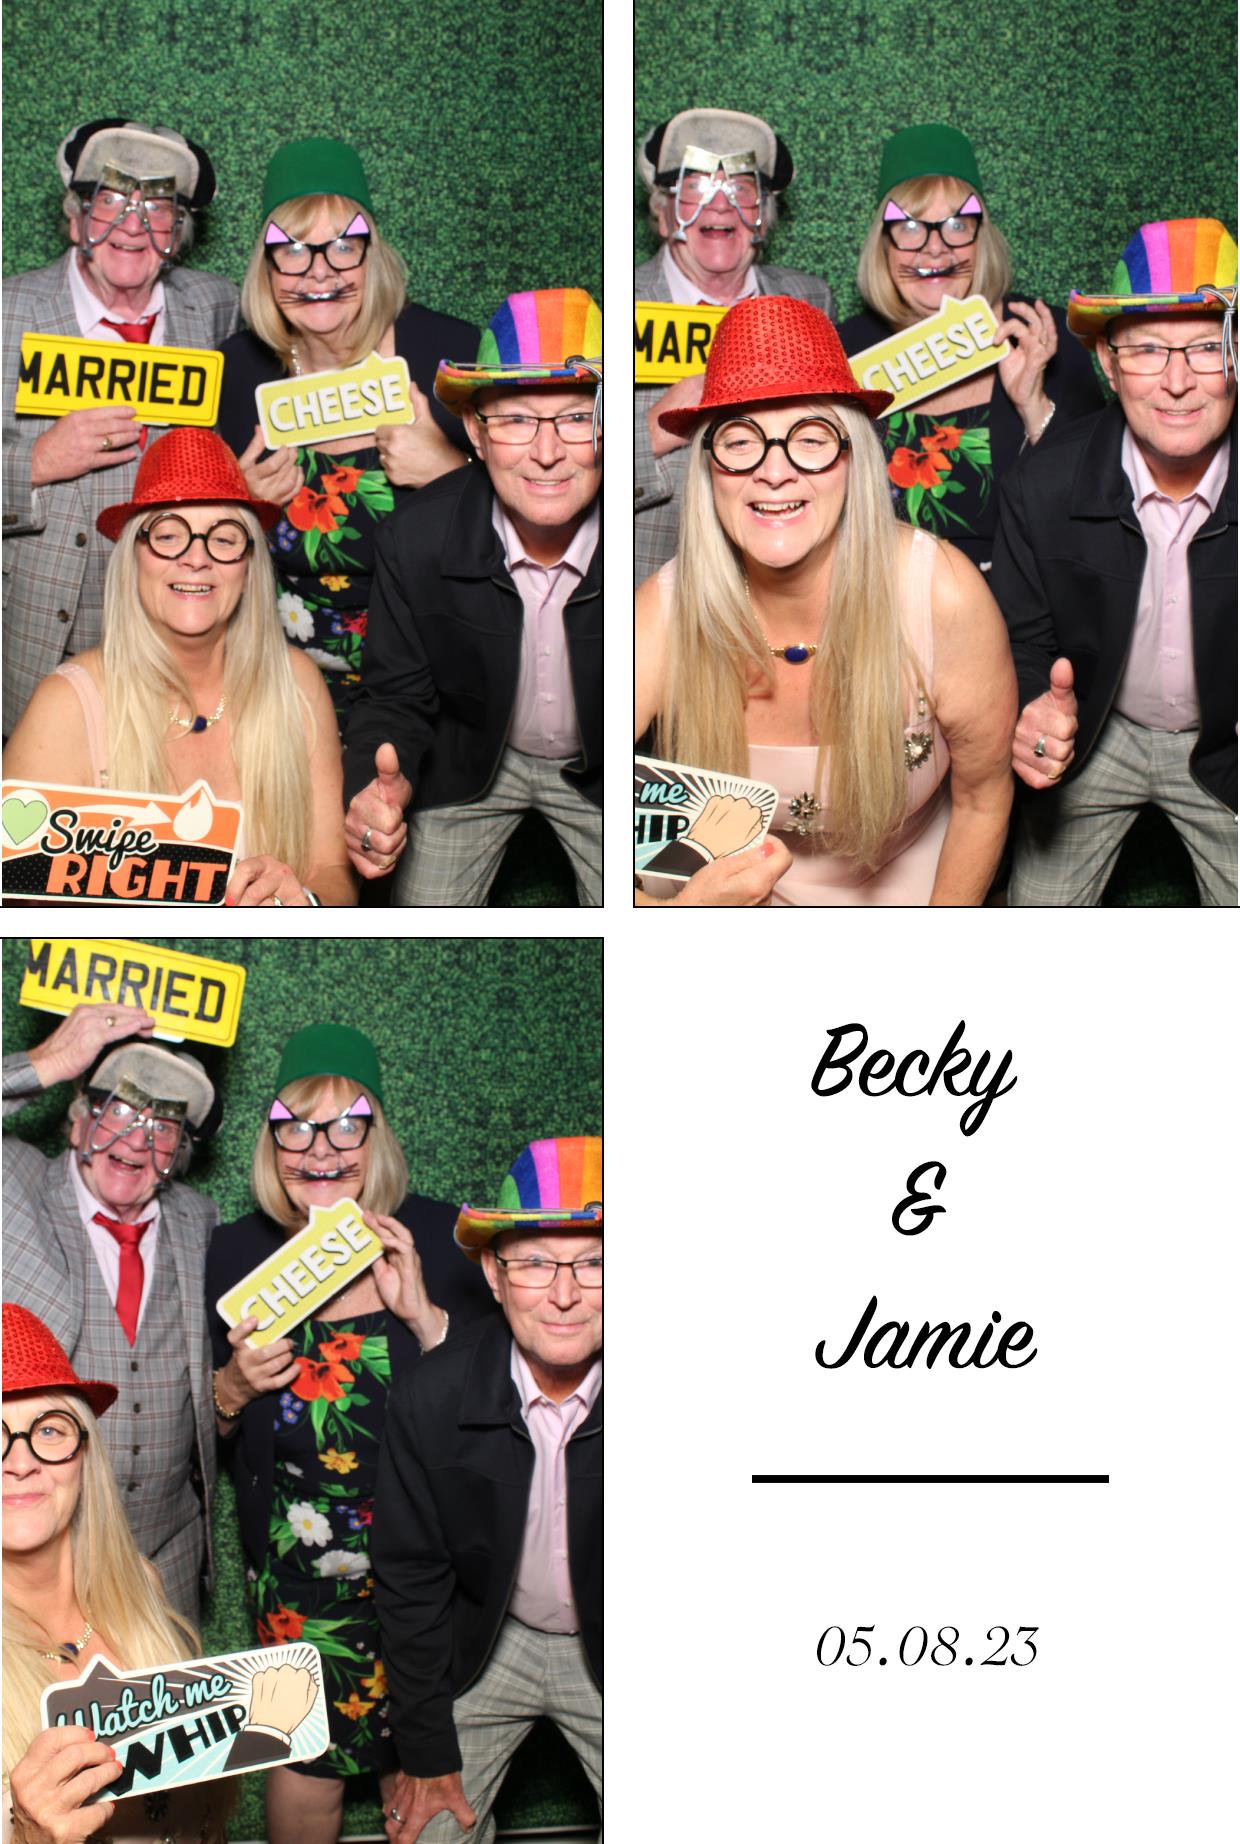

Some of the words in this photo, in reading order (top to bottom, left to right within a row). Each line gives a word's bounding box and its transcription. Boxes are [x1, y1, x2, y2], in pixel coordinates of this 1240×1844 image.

[19, 349, 208, 407] MARRIED
[862, 312, 994, 393] CHEESE
[268, 372, 407, 432] CHEESE
[639, 781, 690, 805] me
[41, 809, 156, 870] Swipe
[46, 853, 229, 902] RIGHT
[26, 942, 227, 1024] MARRIED
[240, 1213, 373, 1332] CHEESE
[184, 1673, 234, 1709] me
[106, 1703, 248, 1797] WHIP
